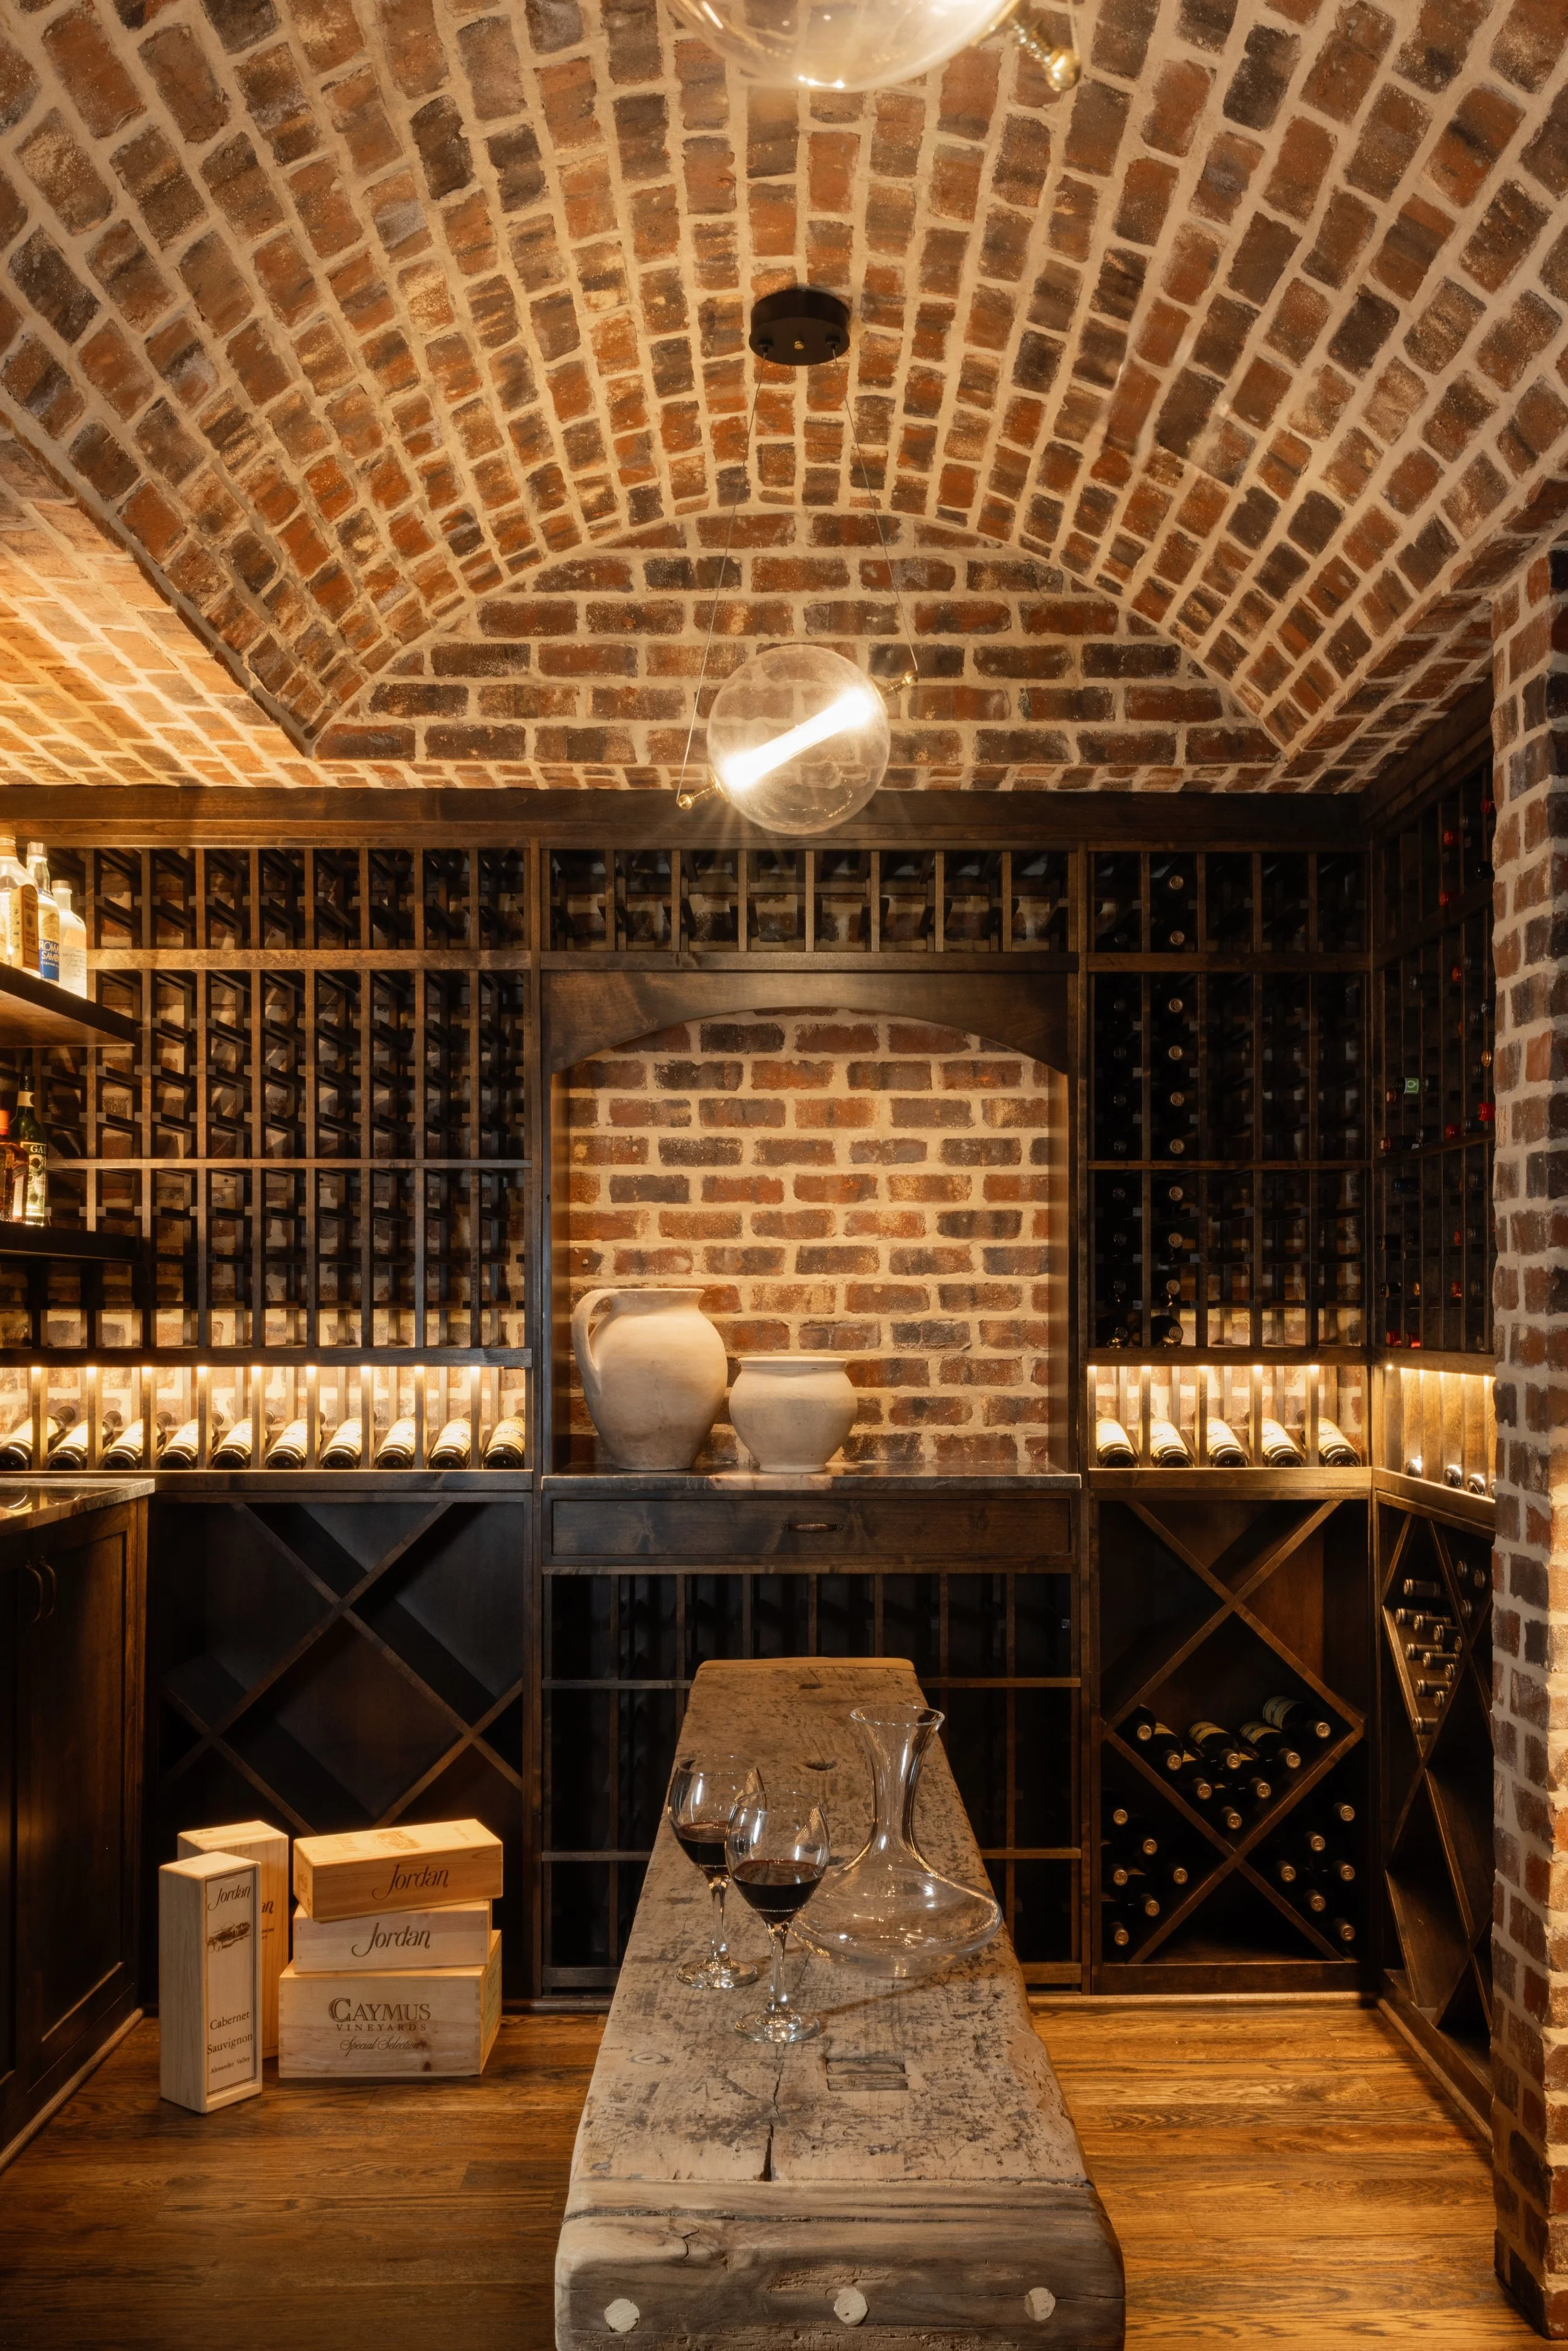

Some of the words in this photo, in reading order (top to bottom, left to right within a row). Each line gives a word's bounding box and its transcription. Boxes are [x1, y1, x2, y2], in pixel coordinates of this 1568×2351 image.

[372, 1864, 449, 1901] Jordan
[207, 1884, 251, 1911] Jordan
[351, 1922, 431, 1958] Jordan
[209, 2011, 250, 2030] Cabernet
[328, 1997, 432, 2023] CAYMUS
[336, 2024, 426, 2032] VINEYARDS
[207, 2033, 253, 2055] Sauvignon
[339, 2035, 379, 2057] Special
[377, 2035, 421, 2051] Selection
[210, 2062, 235, 2074] Alexander
[236, 2056, 251, 2064] Valley
